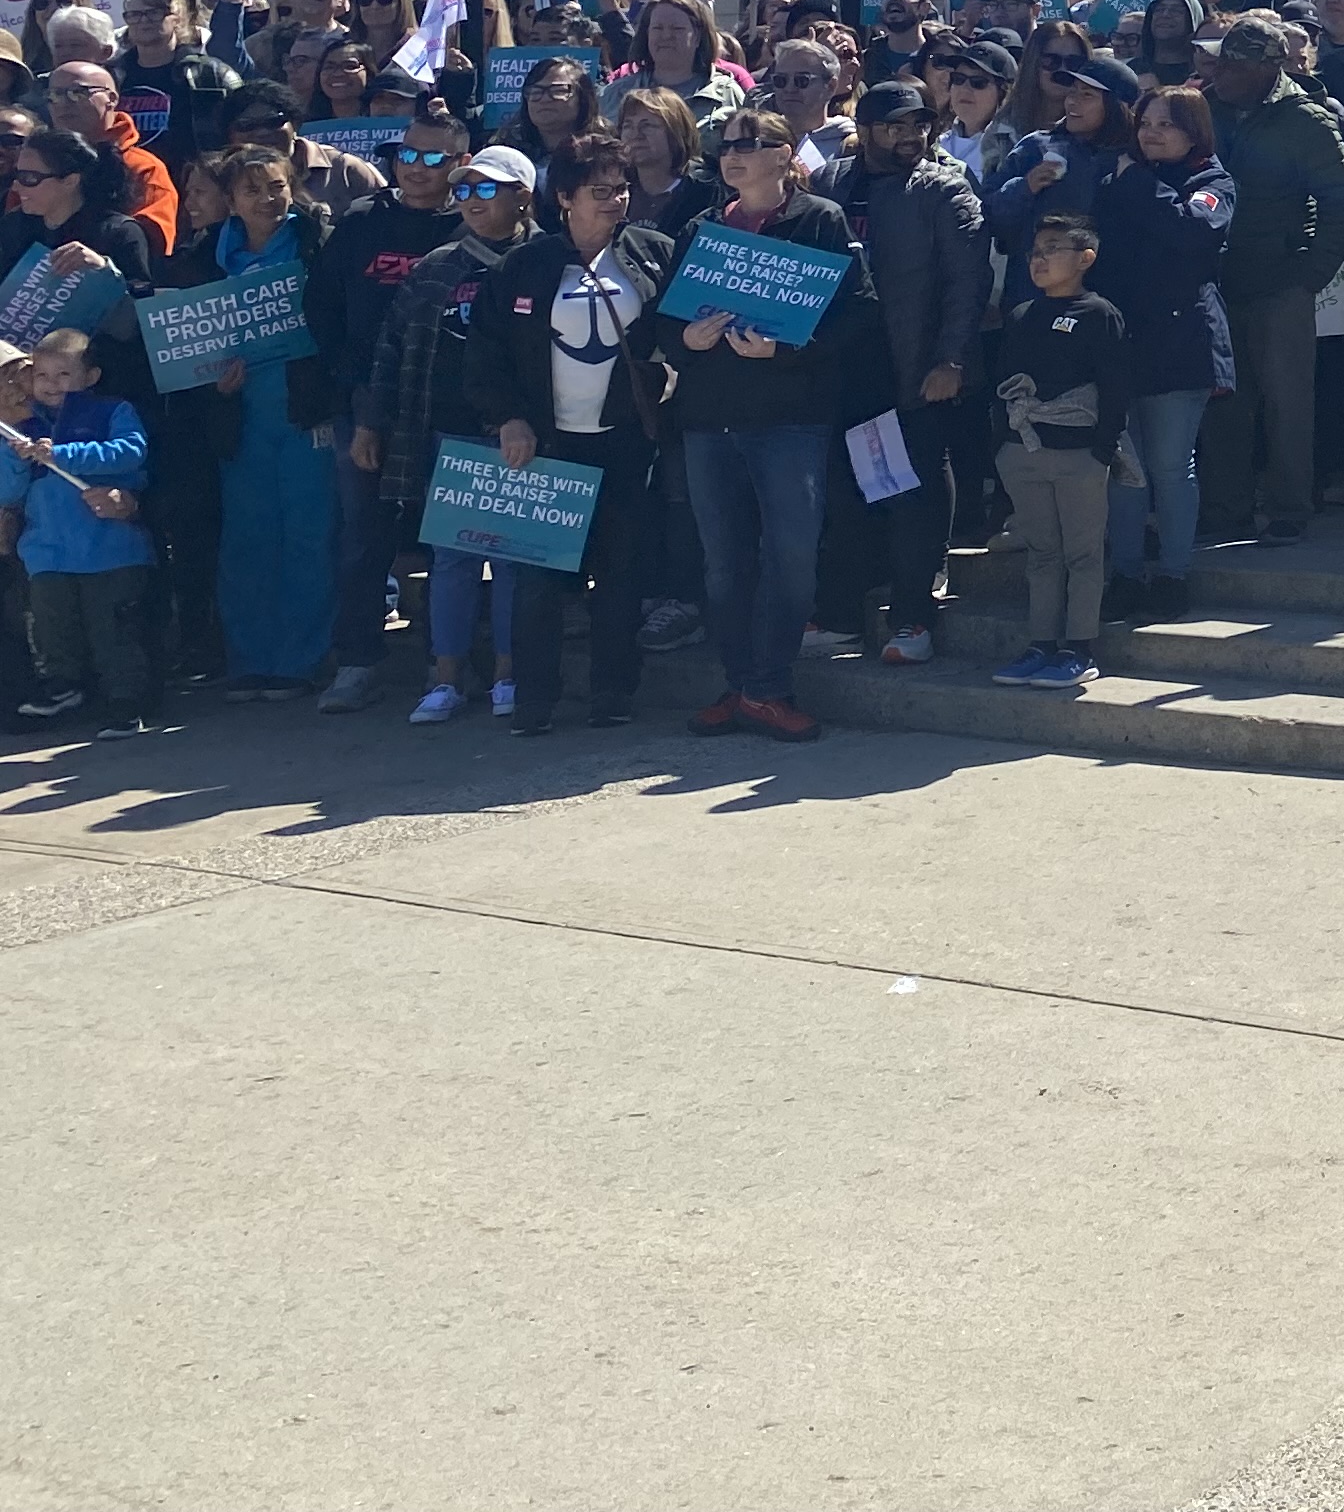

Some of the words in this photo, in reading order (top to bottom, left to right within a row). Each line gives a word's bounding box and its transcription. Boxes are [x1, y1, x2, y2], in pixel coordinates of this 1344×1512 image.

[698, 236, 749, 261] THREE
[750, 249, 799, 272] YEARS
[801, 262, 841, 282] WITH
[723, 257, 748, 274] NO
[750, 264, 803, 287] RAISE?
[148, 292, 238, 329] HEALTH
[242, 276, 300, 306] CARE
[683, 264, 723, 286] FAIR
[725, 276, 771, 299] DEAL
[775, 288, 825, 309] NOW!
[156, 333, 241, 364] DESERVE
[243, 328, 256, 343] A
[260, 313, 307, 338] RAISE
[165, 297, 292, 344] PROVIDERS
[1051, 316, 1078, 333] CAT
[441, 455, 494, 478] THREE
[498, 466, 549, 488] YEARS
[553, 477, 595, 497] WITH
[471, 477, 497, 493] NO
[500, 482, 557, 504] RAISE?
[434, 487, 474, 508] FAIR
[478, 495, 527, 518] DEAL
[531, 505, 584, 528] NOW!
